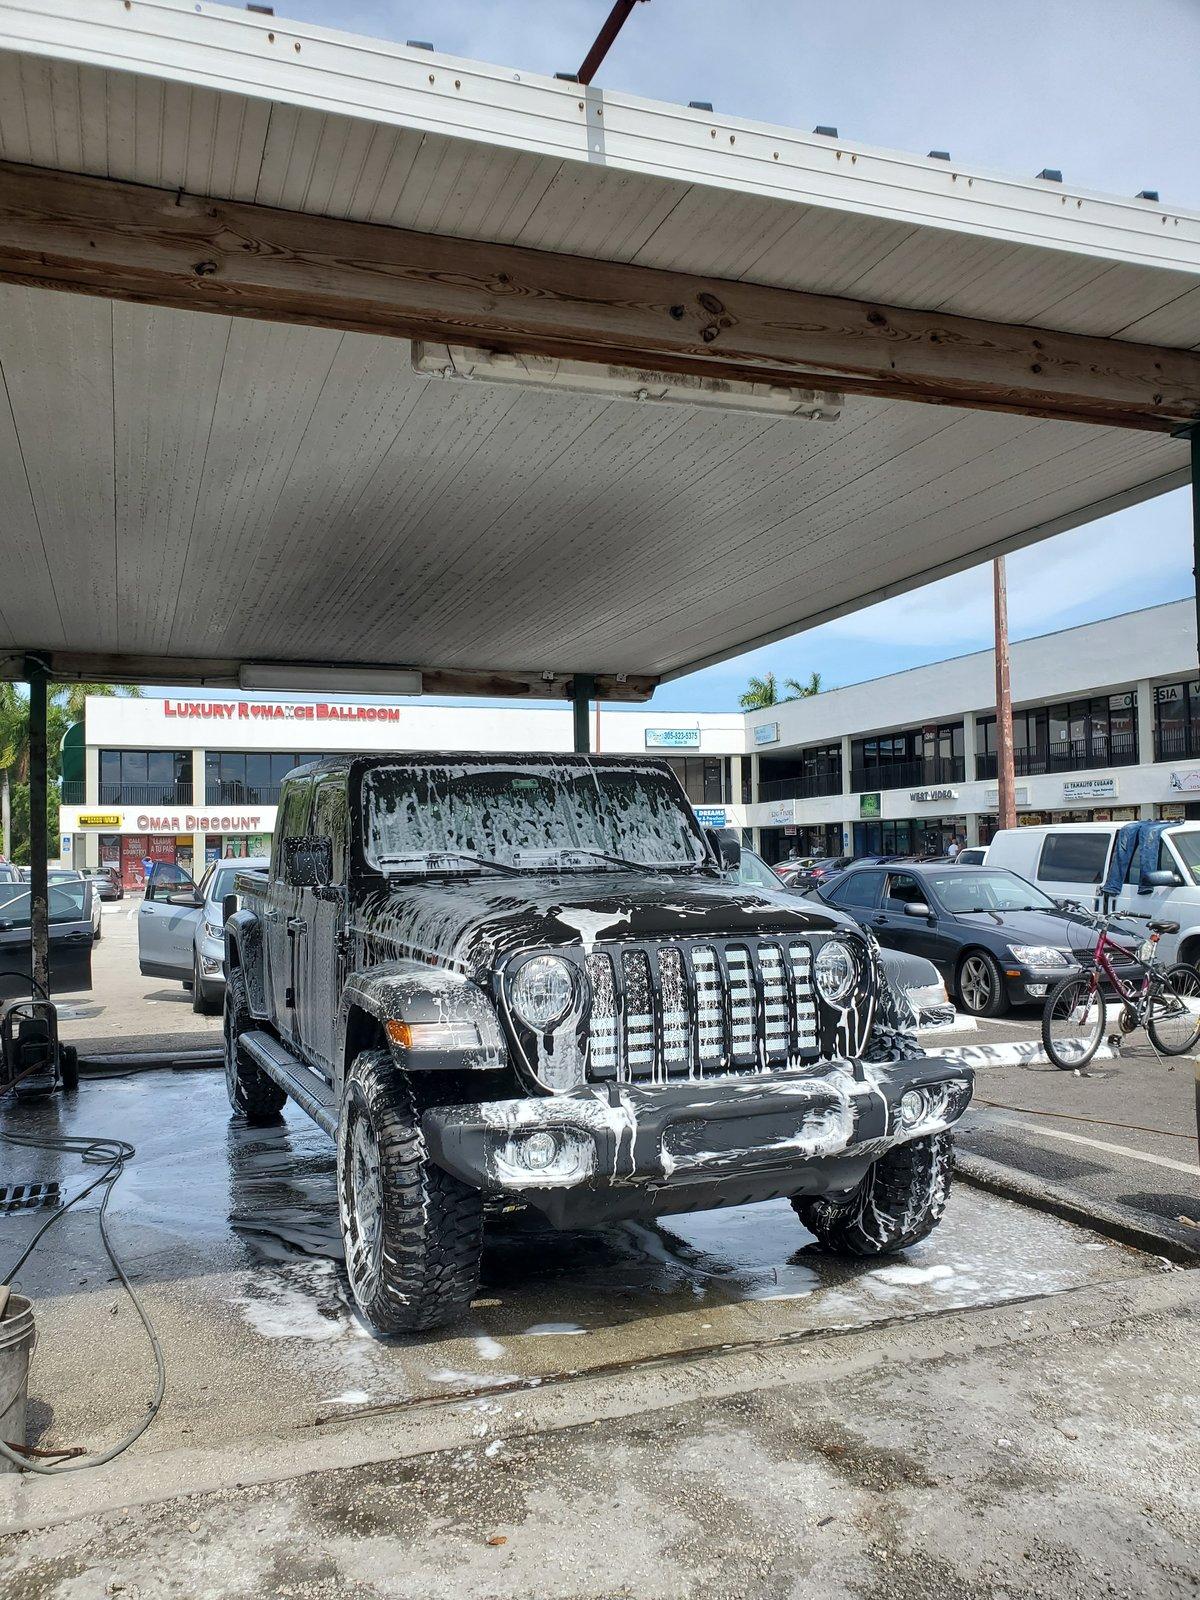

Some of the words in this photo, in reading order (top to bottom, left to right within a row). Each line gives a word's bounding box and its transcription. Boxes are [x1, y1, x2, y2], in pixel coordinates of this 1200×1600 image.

[164, 700, 235, 717] LUXURY
[316, 703, 400, 722] BALLROOM
[909, 791, 928, 801] WEST
[930, 789, 952, 799] VIDEO
[137, 815, 180, 831] OMAR
[186, 815, 261, 831] DISCOUNT
[941, 1045, 1001, 1060] CAR
[1013, 1039, 1085, 1057] WSH
